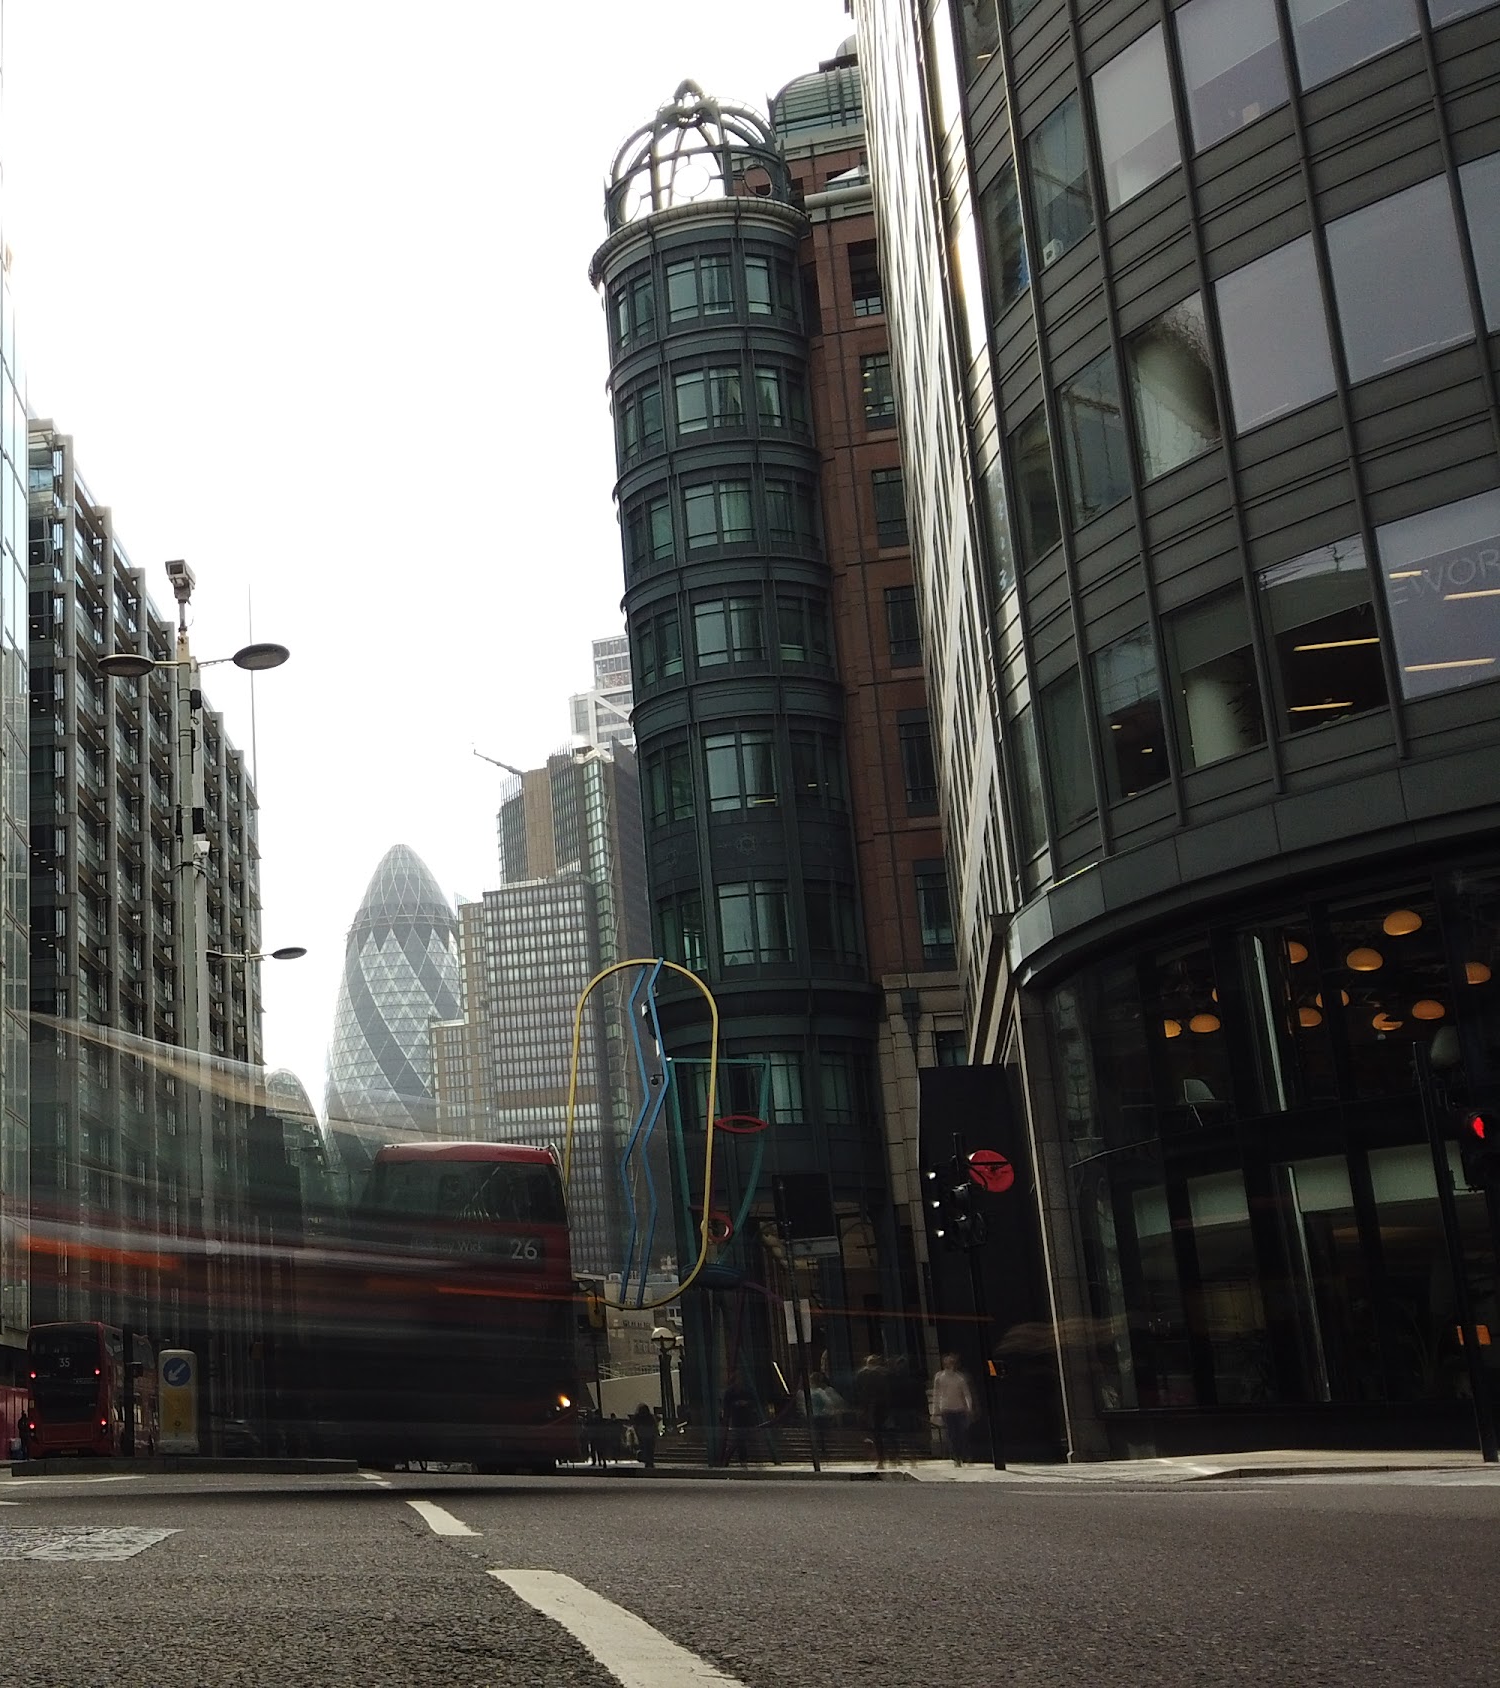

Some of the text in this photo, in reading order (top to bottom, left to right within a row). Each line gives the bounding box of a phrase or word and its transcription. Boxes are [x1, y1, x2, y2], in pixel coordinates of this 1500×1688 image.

[457, 1239, 484, 1253] Wick
[510, 1238, 538, 1260] 26
[59, 1357, 71, 1368] 35
